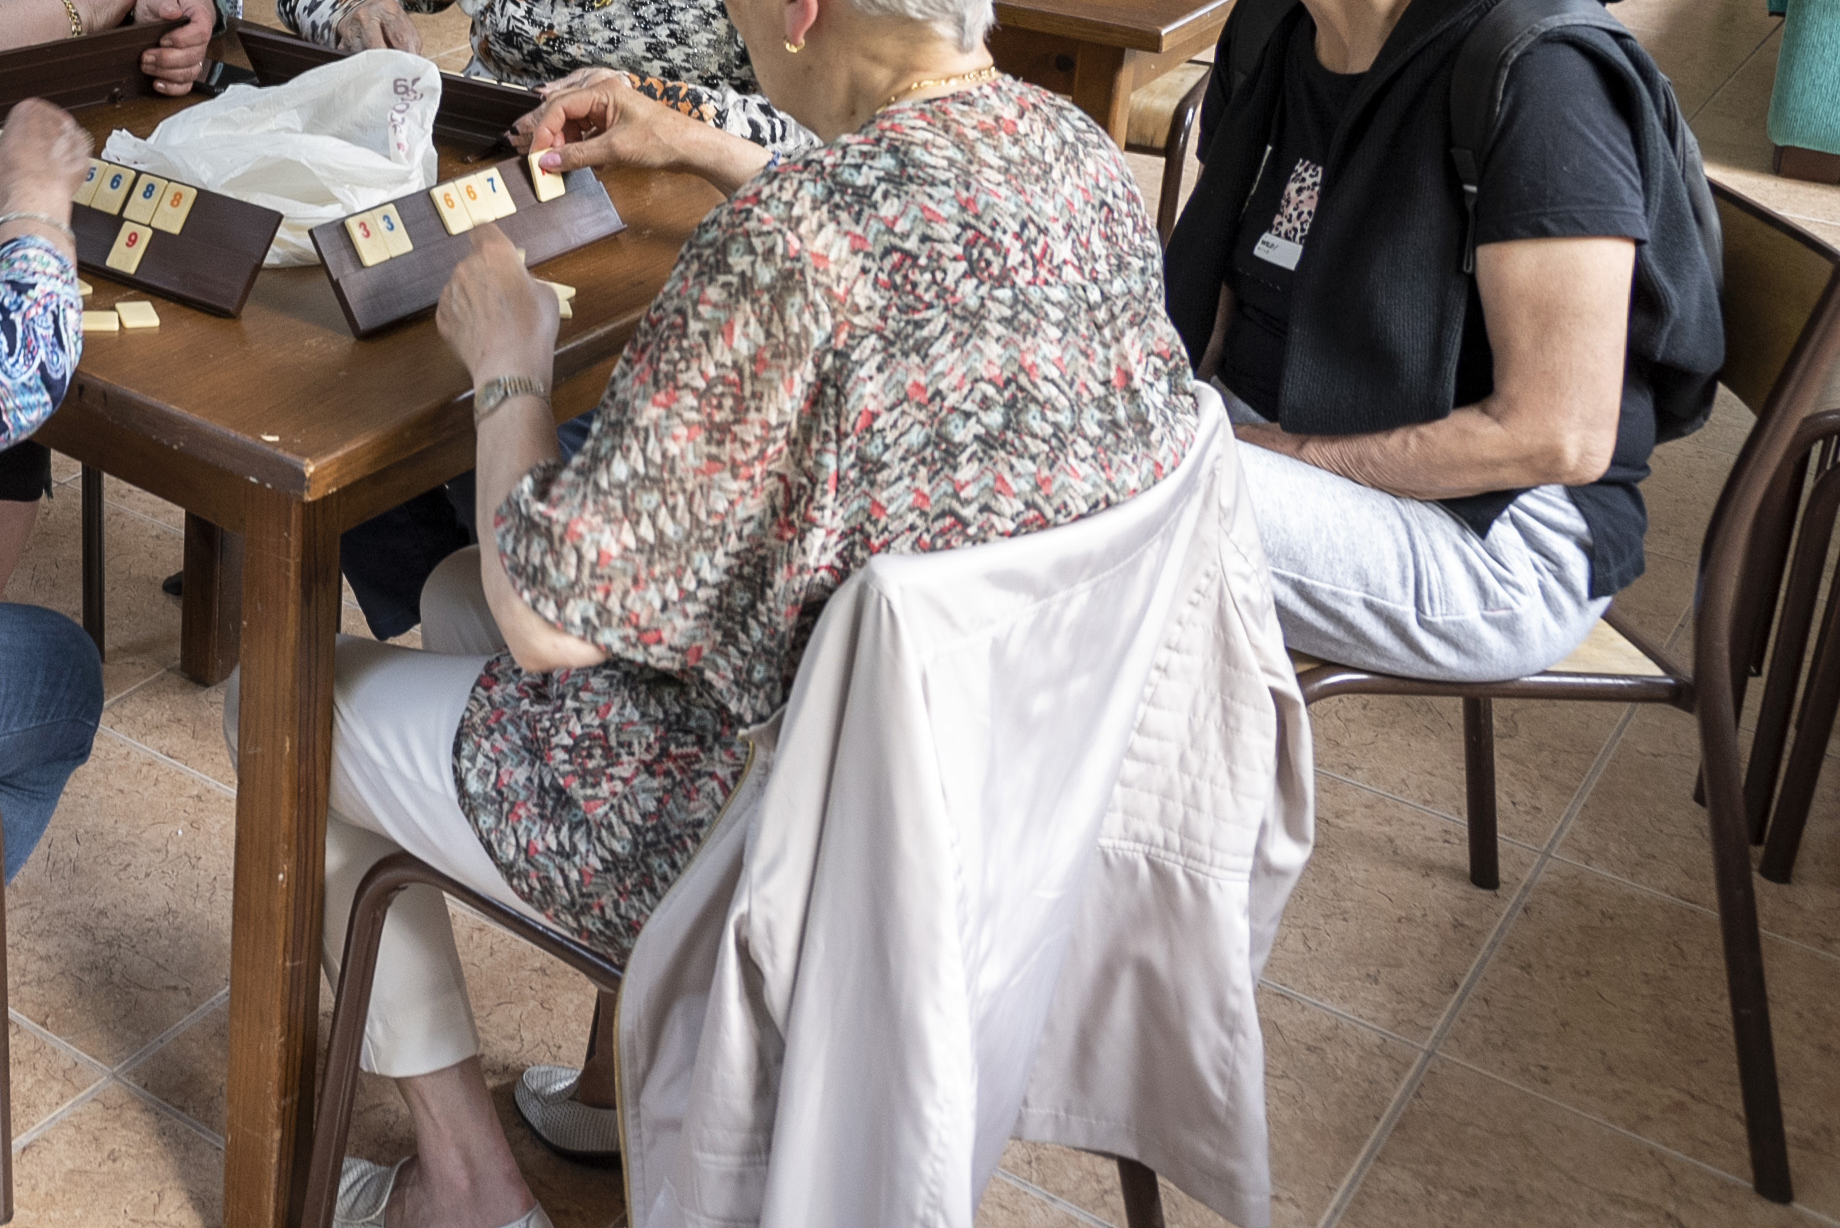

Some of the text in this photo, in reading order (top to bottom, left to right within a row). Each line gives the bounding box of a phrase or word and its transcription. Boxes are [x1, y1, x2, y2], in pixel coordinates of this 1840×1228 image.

[110, 173, 123, 190] 6
[486, 177, 498, 193] 7
[142, 183, 155, 199] 8
[169, 191, 183, 208] 8
[465, 184, 478, 201] 6
[443, 192, 455, 209] 6
[358, 221, 371, 239] 3
[382, 214, 395, 232] 3
[125, 231, 138, 248] 9
